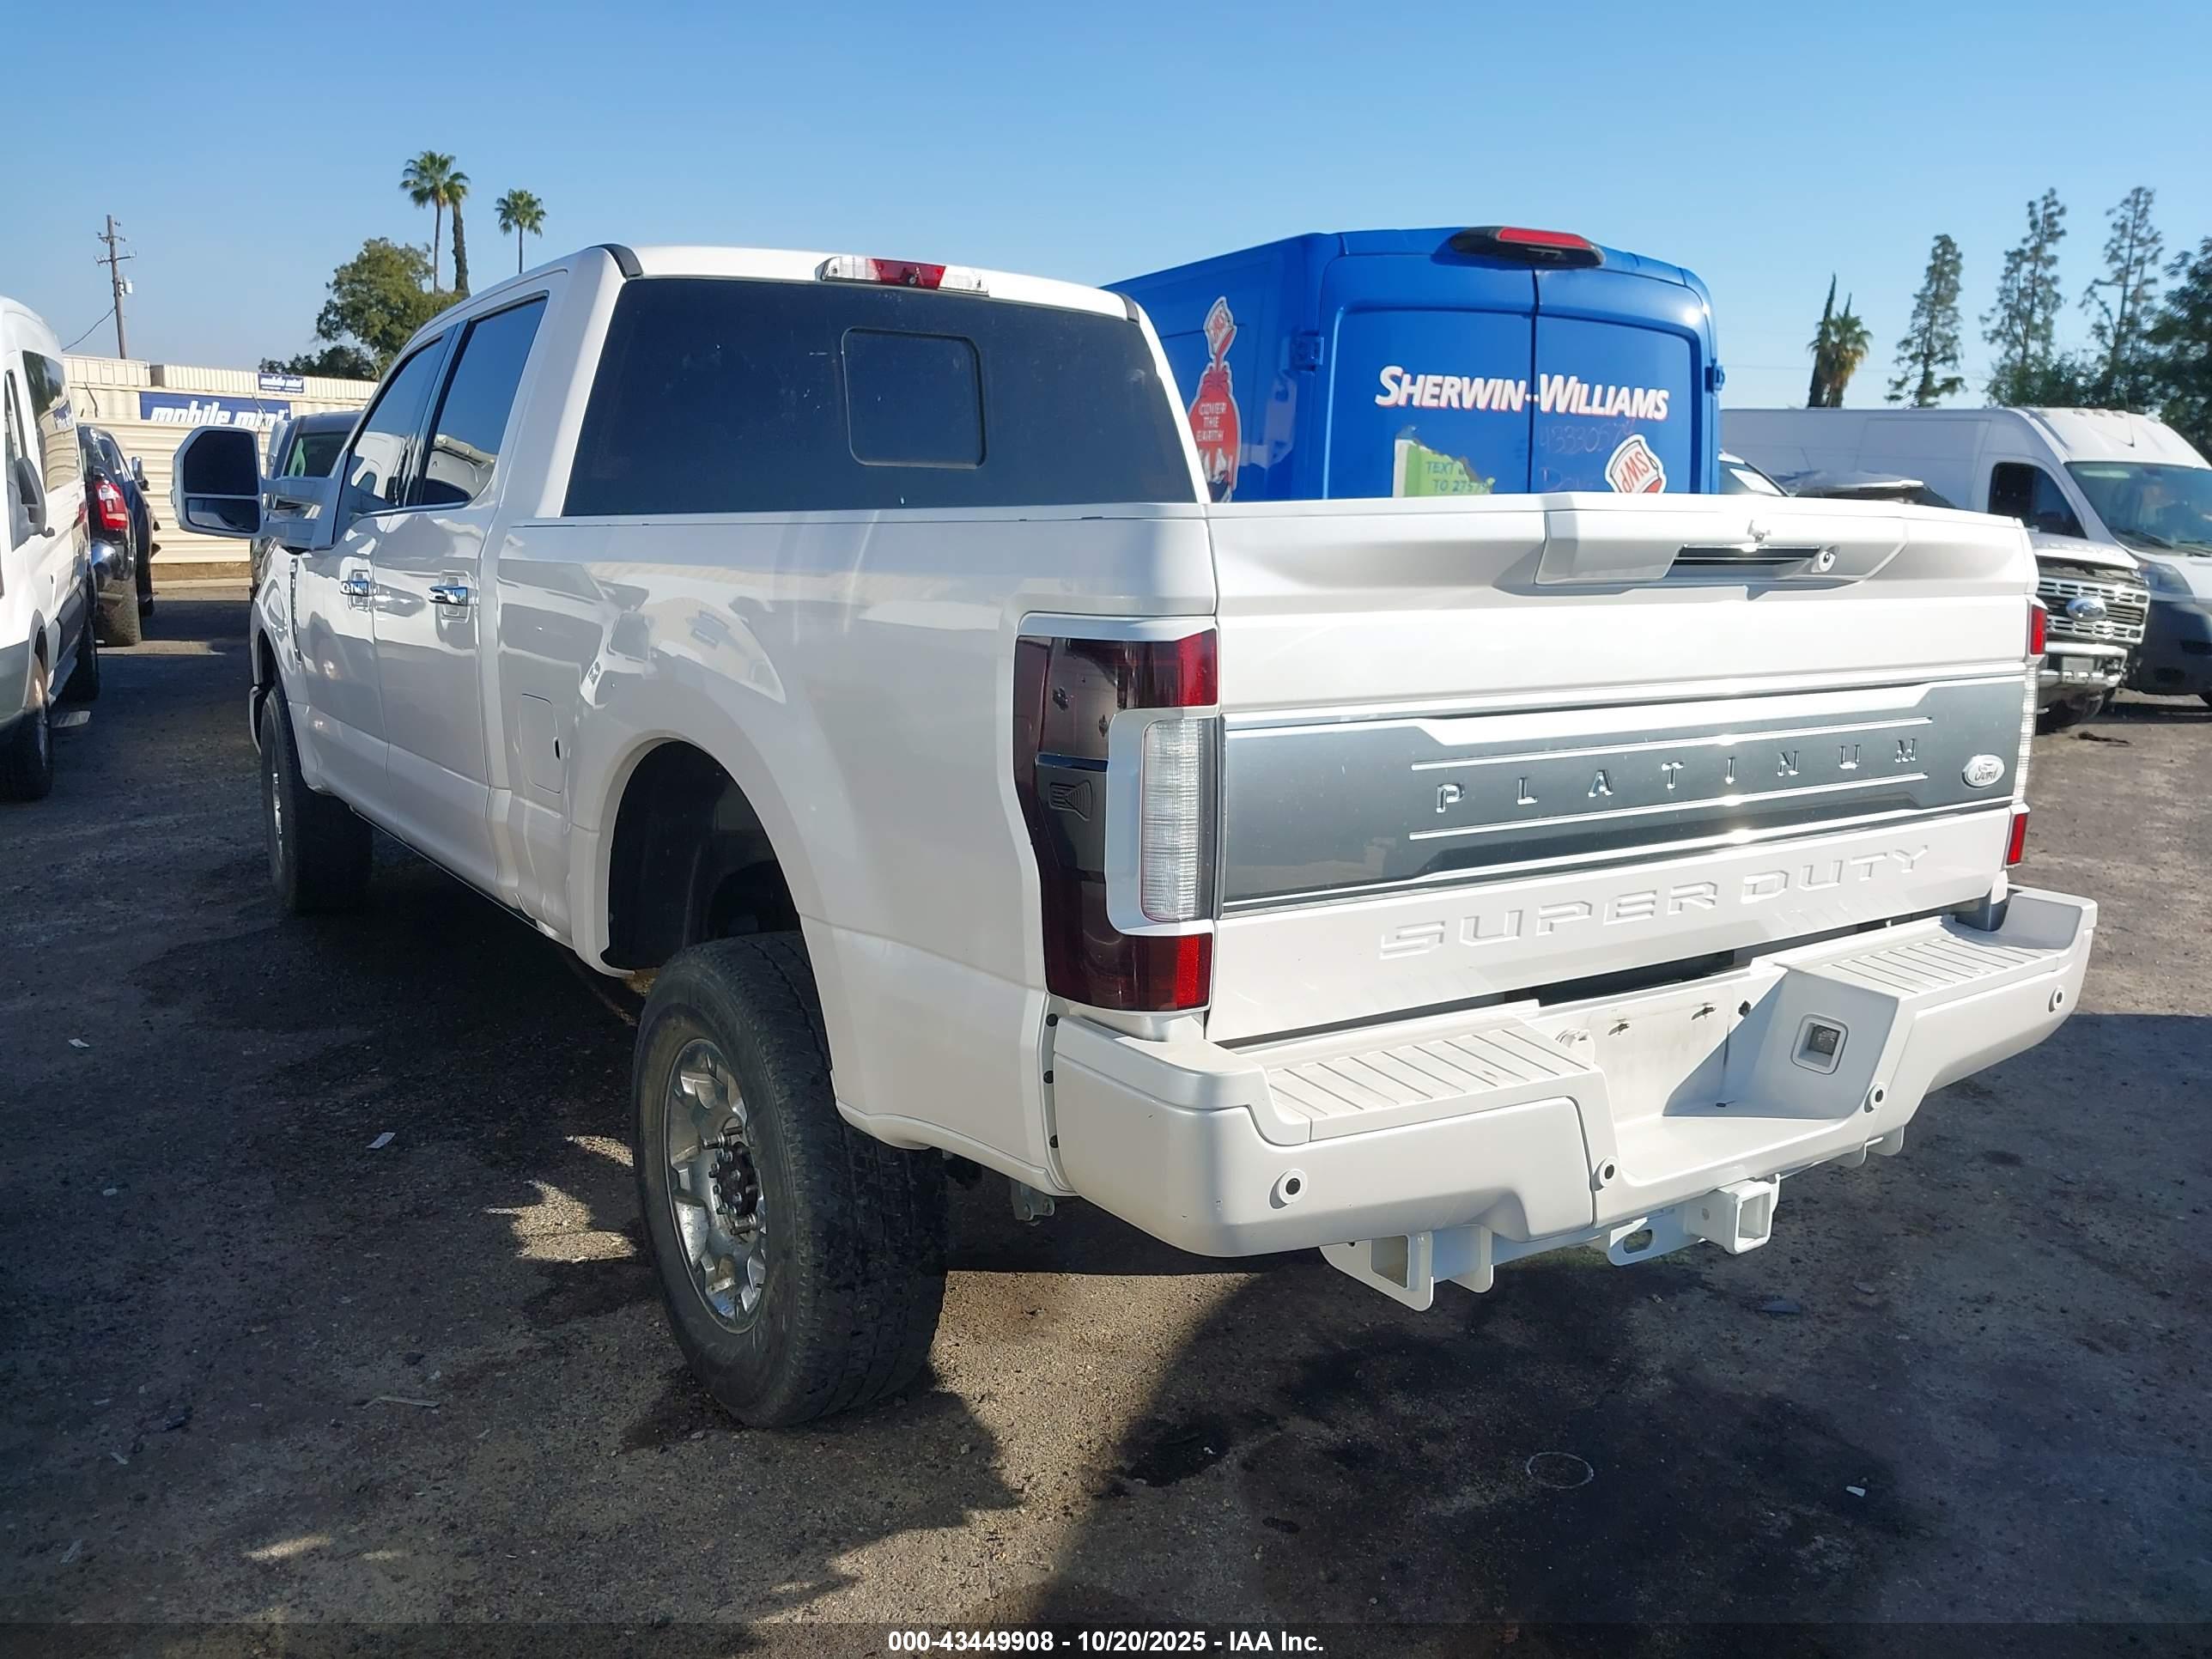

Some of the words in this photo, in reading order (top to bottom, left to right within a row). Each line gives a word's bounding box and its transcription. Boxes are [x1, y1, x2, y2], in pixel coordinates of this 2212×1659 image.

[150, 401, 231, 425] mobile
[1199, 402, 1227, 416] COVER
[1203, 416, 1220, 428] THE
[1196, 429, 1224, 442] EARTH
[1427, 461, 1454, 474] TEXT
[1433, 478, 1449, 492] TO
[1436, 738, 1918, 813] PLATINUM
[1378, 879, 1718, 960] SUPER
[1741, 844, 1929, 904] DUTY
